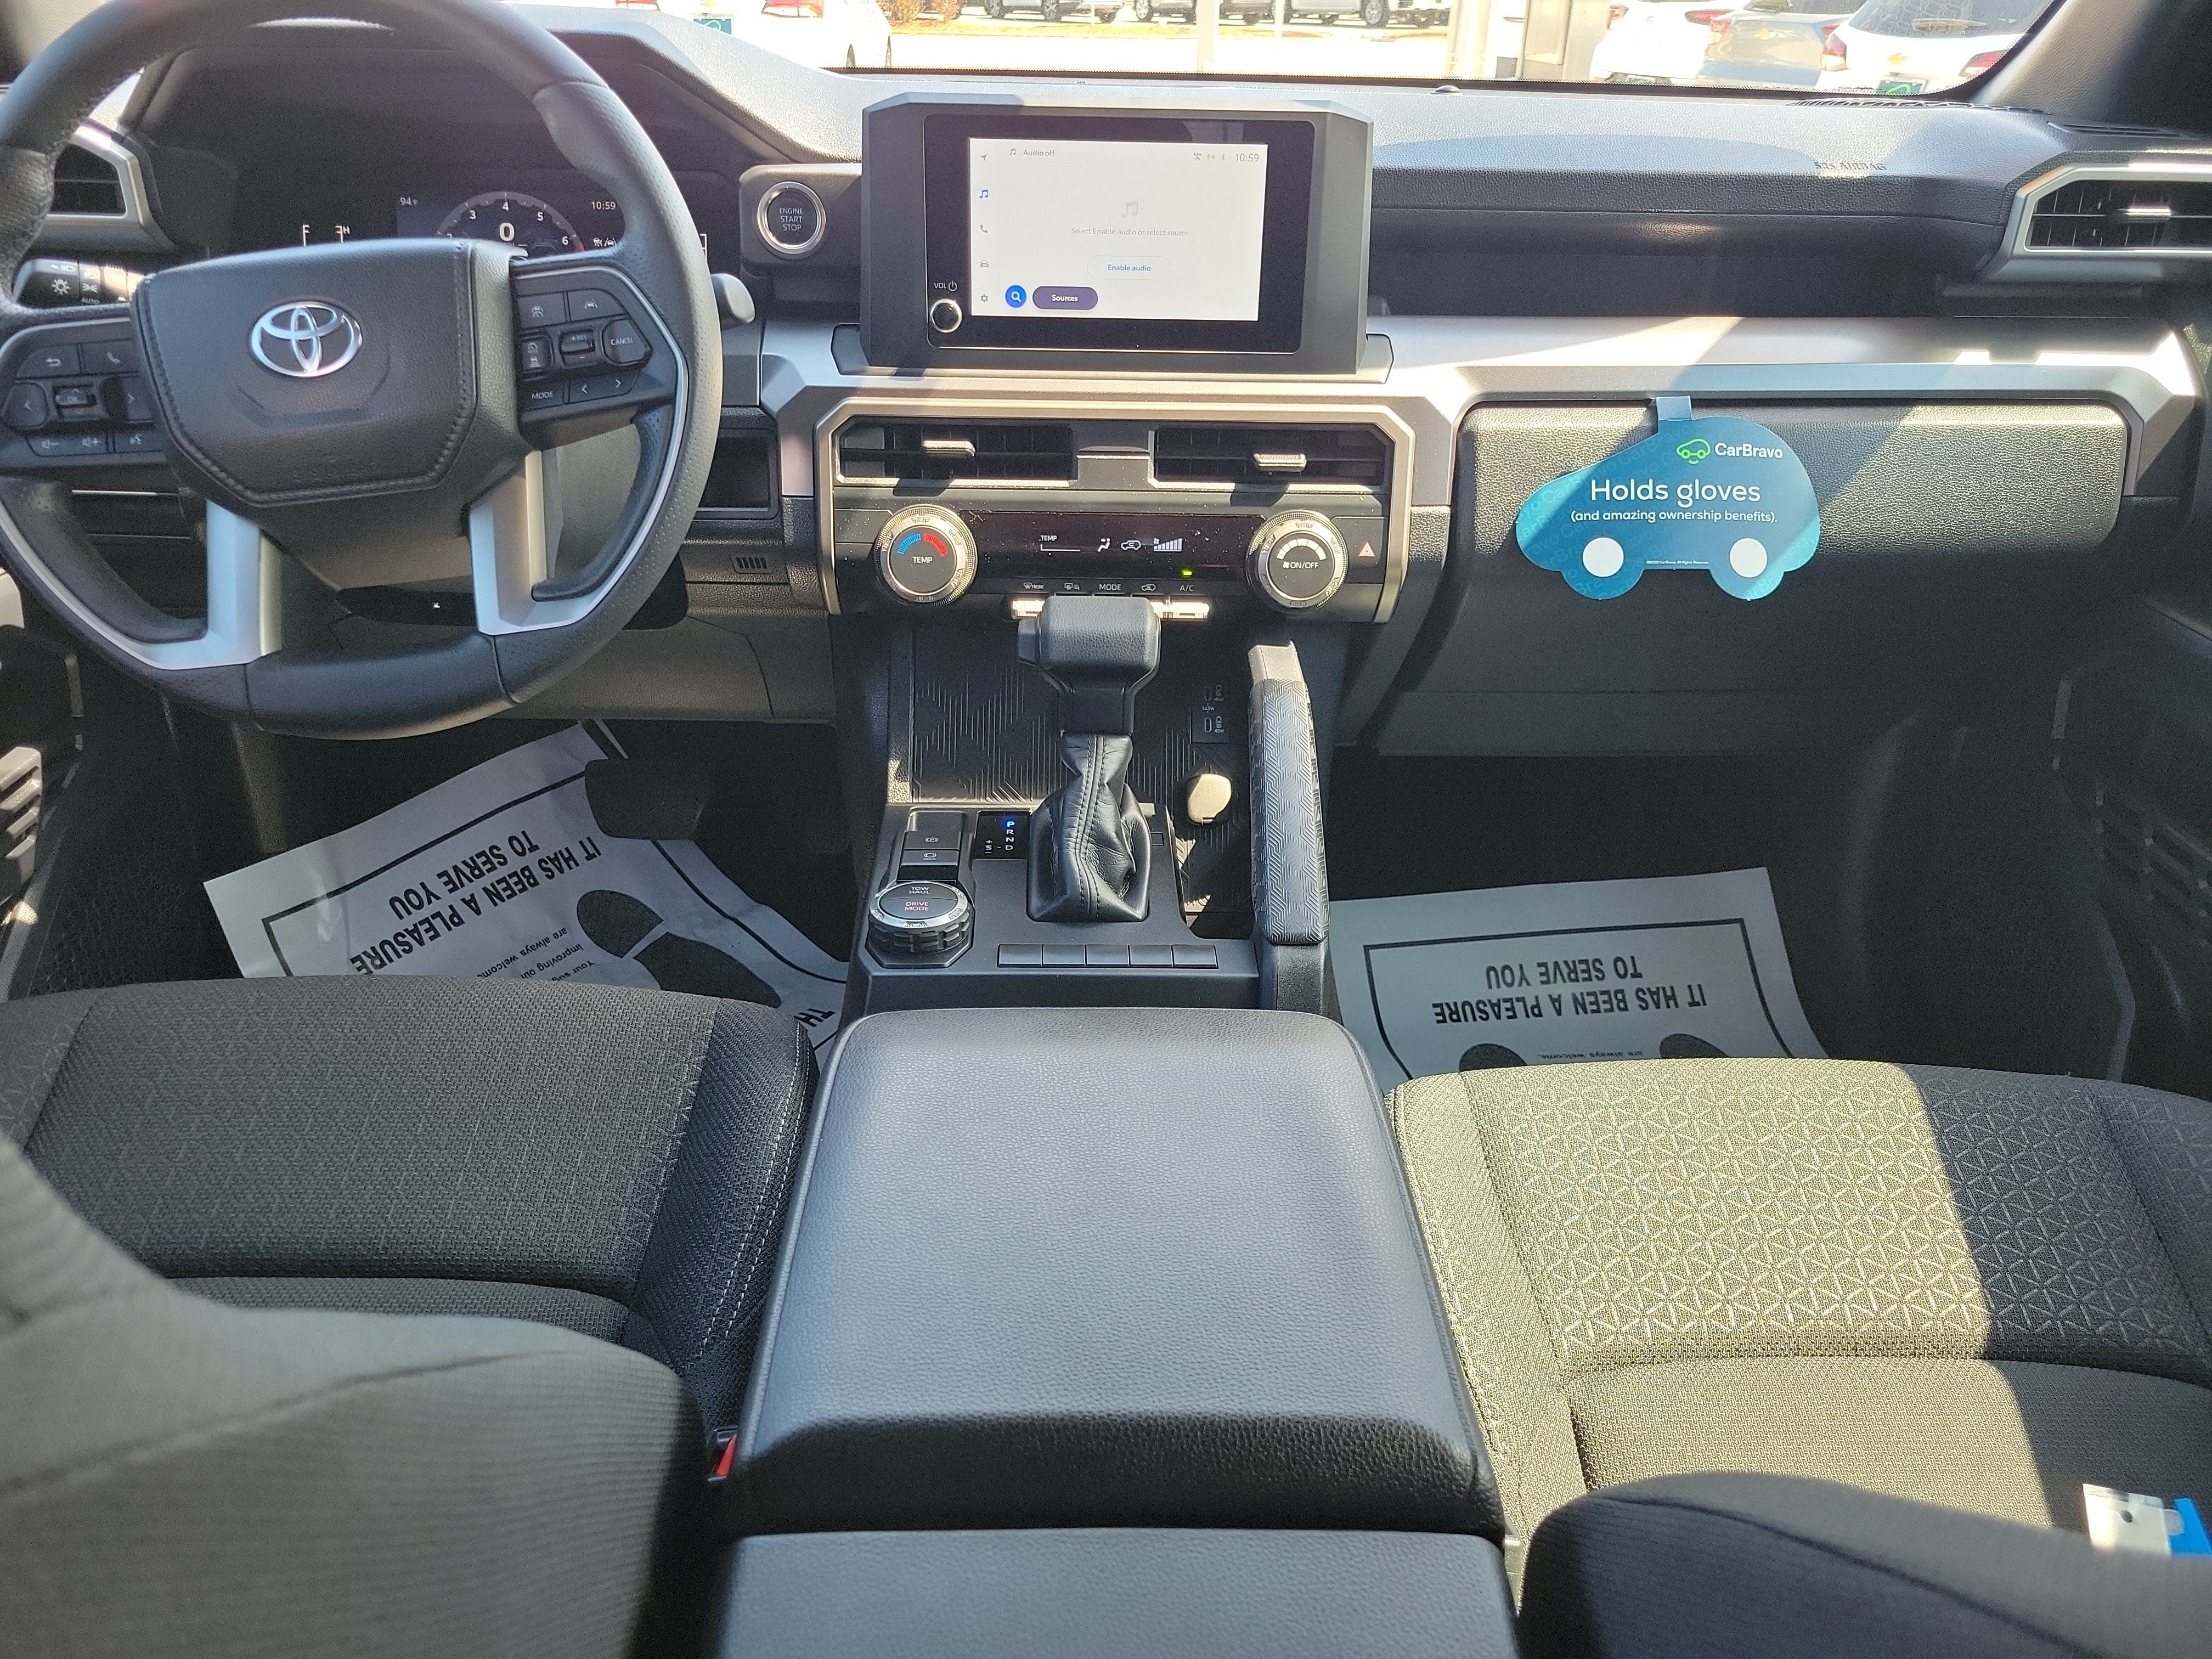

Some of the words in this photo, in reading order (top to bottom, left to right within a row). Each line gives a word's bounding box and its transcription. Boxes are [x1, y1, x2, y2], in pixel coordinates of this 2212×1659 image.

[1235, 153, 1259, 162] 10:59
[470, 210, 476, 219] 3
[502, 202, 509, 211] 4
[537, 212, 544, 221] 5
[591, 201, 616, 210] 10:59
[343, 225, 351, 235] H
[499, 222, 515, 241] 0
[562, 236, 569, 245] 6
[611, 337, 633, 346] CANCEL
[532, 390, 553, 399] MODE
[1714, 442, 1784, 459] CarBravo
[1592, 478, 1669, 500] Holds
[1677, 478, 1760, 508] gloves
[1571, 510, 1600, 522] (and
[1602, 510, 1656, 522] amazing
[1659, 510, 1722, 522] ownership
[1725, 511, 1778, 523] benefits).
[507, 830, 540, 857] TO
[578, 836, 602, 861] IT
[436, 844, 508, 894] SERVE
[537, 847, 580, 880] HAS
[482, 865, 540, 907] BEEN
[389, 881, 442, 920] YOU
[460, 892, 483, 917] A
[349, 904, 465, 975] PLEASURE
[552, 928, 568, 939] are
[520, 936, 551, 956] always
[537, 944, 584, 971] improving
[572, 960, 596, 974] Your
[1486, 963, 1531, 989] YOU
[1538, 958, 1604, 985] SERVE
[1613, 955, 1643, 979] TO
[1548, 994, 1562, 1016] A
[1571, 989, 1629, 1015] BEEN
[1635, 985, 1679, 1011] HAS
[1688, 984, 1707, 1007] IT
[1432, 995, 1543, 1024] PLEASURE
